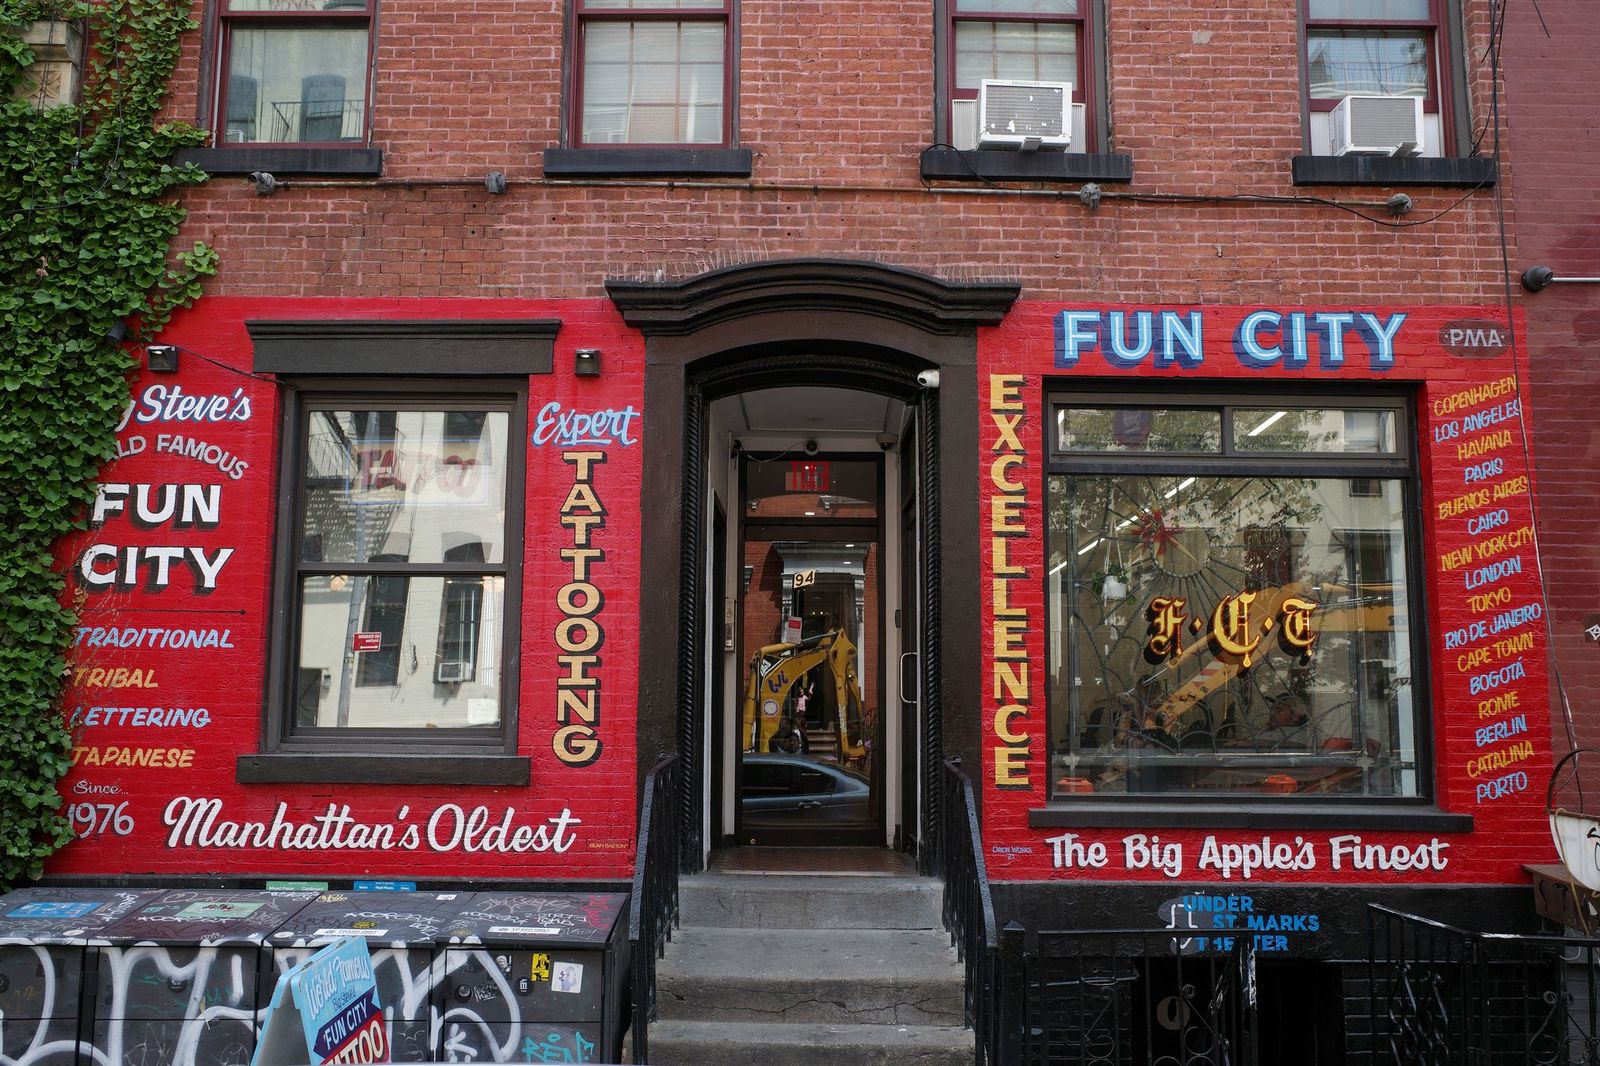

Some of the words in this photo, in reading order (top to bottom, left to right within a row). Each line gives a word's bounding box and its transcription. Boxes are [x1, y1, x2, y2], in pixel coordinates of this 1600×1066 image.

[1058, 311, 1203, 364] FUN
[1237, 311, 1406, 366] CITY
[1450, 329, 1503, 347] PMA
[137, 384, 251, 423] Steve's
[1433, 374, 1518, 416] COPENHAGEN
[533, 402, 640, 446] Expert
[1434, 421, 1459, 443] LOS
[157, 434, 249, 480] FAMOUS
[1457, 430, 1512, 461] HAVANA
[1464, 457, 1503, 485] PARIS
[91, 483, 221, 526] FUN
[1438, 488, 1490, 520] BUENOS
[1493, 475, 1528, 501] AIRES
[1468, 509, 1509, 535] CAIRO
[80, 543, 235, 589] CITY
[1441, 545, 1472, 571] NEW
[1474, 534, 1508, 559] YORK
[1508, 526, 1535, 548] CITY
[795, 571, 814, 587] 94
[989, 374, 1029, 786] EXCELLENCE
[1465, 555, 1521, 590] LONDON
[552, 451, 606, 765] TATTOOING
[1467, 587, 1511, 614] TOKYO
[74, 627, 234, 649] TRADITIONAL
[1445, 629, 1468, 650] RIO
[1469, 621, 1488, 641] DE
[1490, 603, 1542, 634] JANEIRO
[1457, 647, 1492, 672] CAPE
[1492, 632, 1534, 658] TOWN
[73, 667, 158, 688] TRIBAL
[1478, 691, 1520, 720] ROME
[1475, 714, 1527, 748] BERLIN
[1467, 740, 1535, 778] CATALINA
[1476, 771, 1528, 804] PORTO
[67, 801, 134, 838] 1976
[164, 796, 420, 850] Manhattan's
[428, 803, 582, 853] Oldest
[1045, 832, 1109, 868] The
[1122, 834, 1182, 877] Big
[1199, 835, 1316, 878] Apple's
[1329, 834, 1450, 870] Finest
[1182, 896, 1254, 913] UNDER
[1248, 914, 1320, 932] MARKS
[305, 962, 337, 1021] World
[323, 1016, 347, 1050] FUN
[346, 998, 368, 1031] CITY
